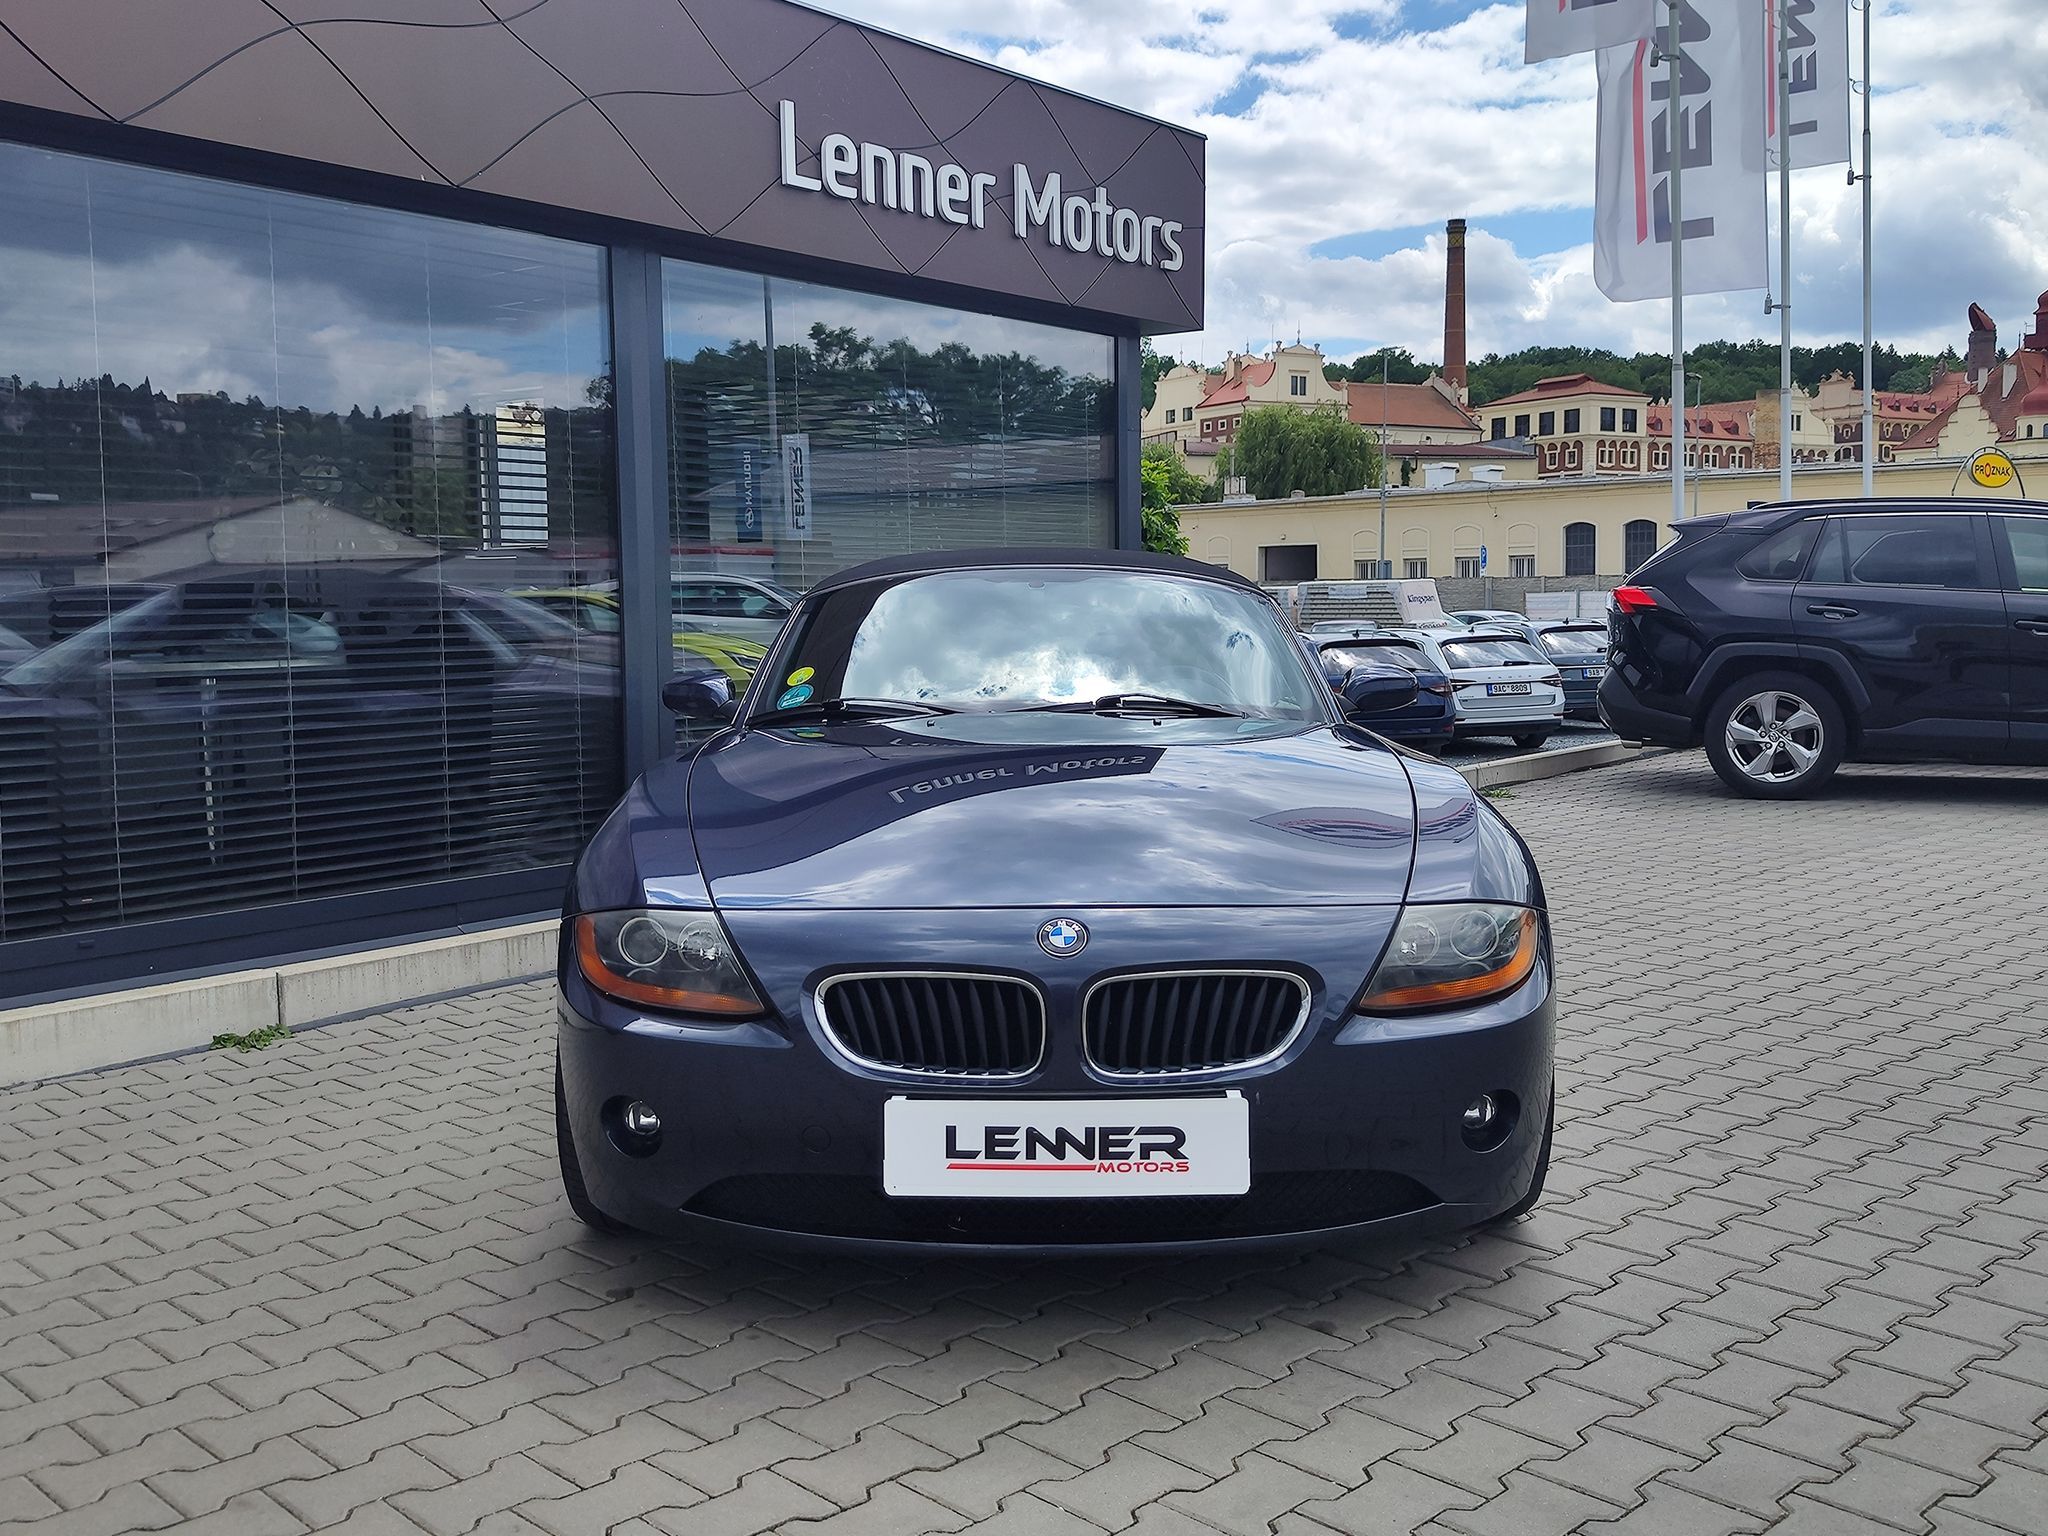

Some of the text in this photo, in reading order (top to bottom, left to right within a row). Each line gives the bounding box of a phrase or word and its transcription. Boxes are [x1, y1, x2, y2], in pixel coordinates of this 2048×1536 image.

[778, 99, 1184, 272] Lenner Motors
[1044, 920, 1081, 932] BMW
[945, 1125, 1190, 1160] LENNER
[1097, 1161, 1190, 1173] MOTORS
